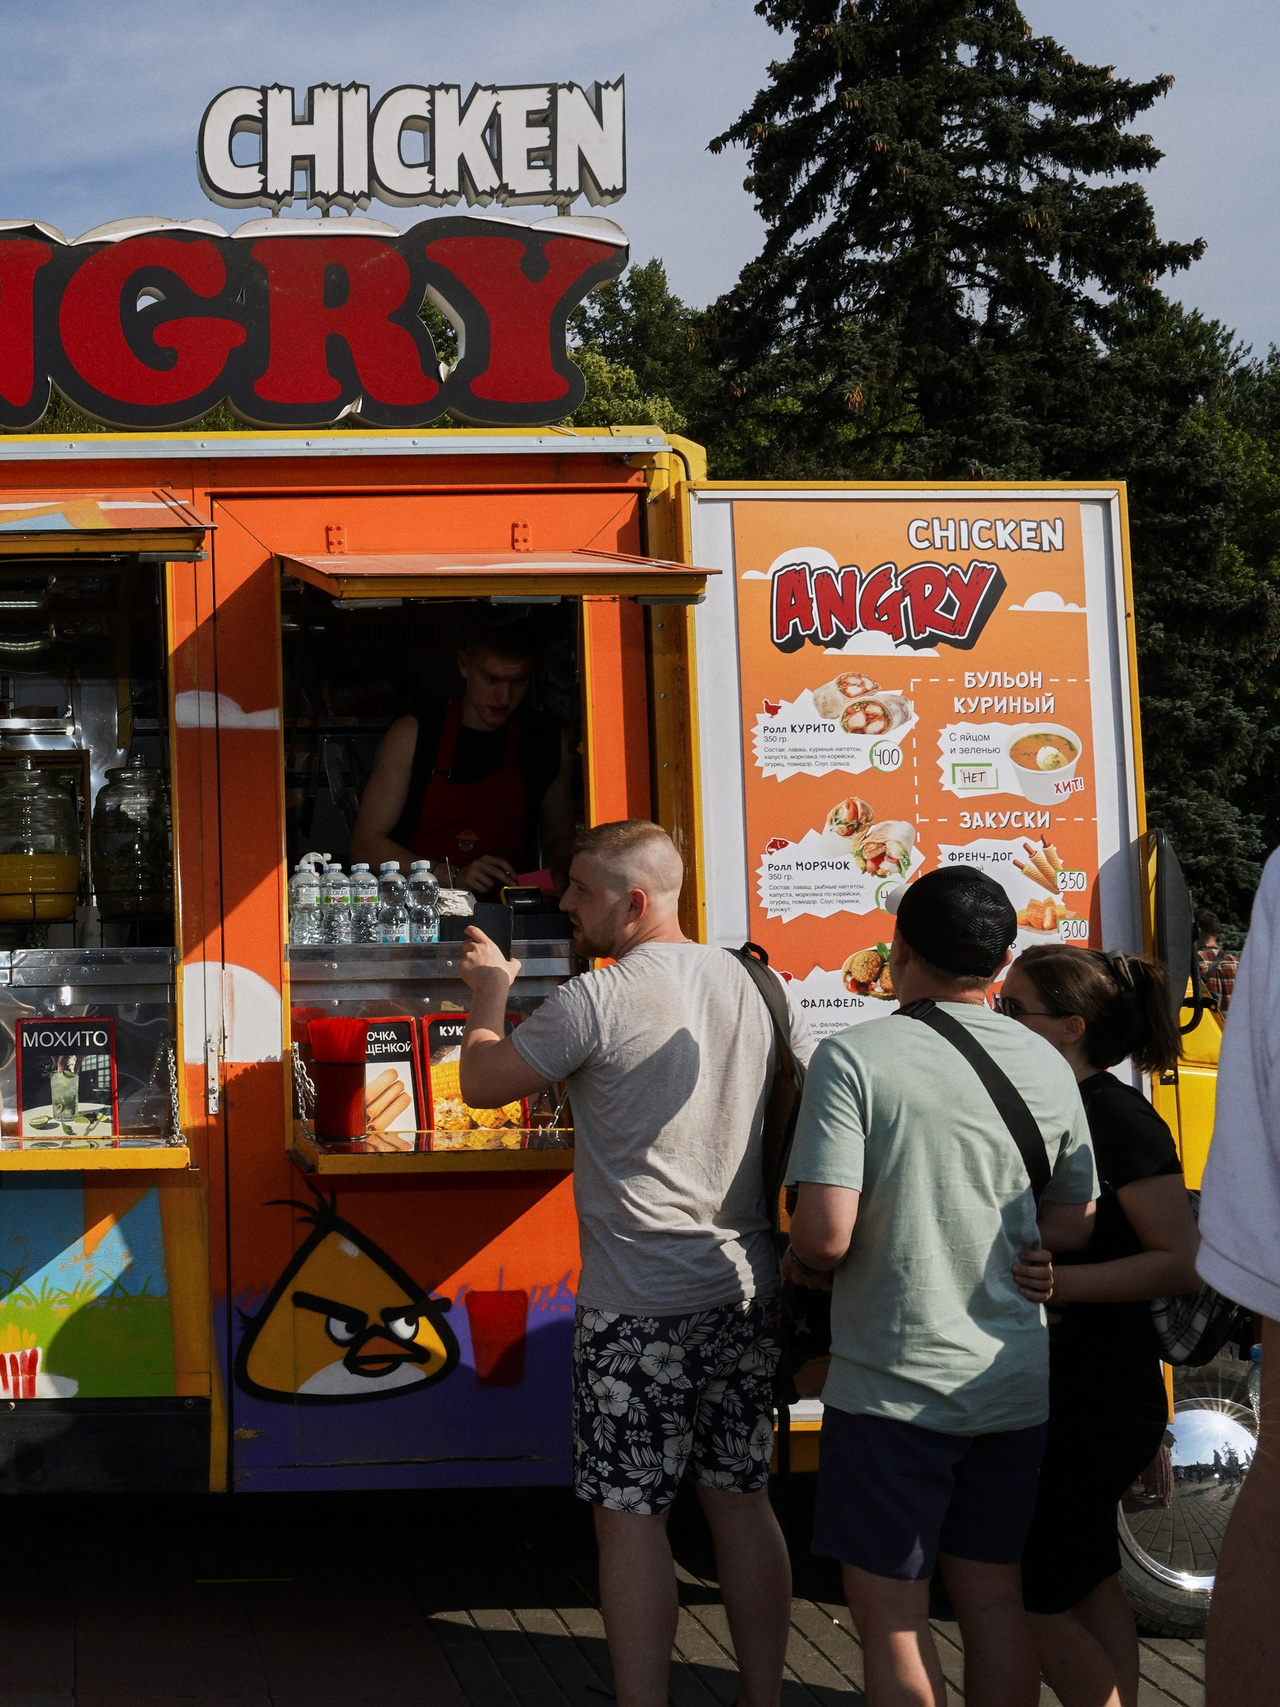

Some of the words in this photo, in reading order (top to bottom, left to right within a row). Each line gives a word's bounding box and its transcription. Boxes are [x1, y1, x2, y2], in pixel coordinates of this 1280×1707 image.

[201, 82, 626, 205] CHICKEN
[907, 517, 1065, 552] CHICKEN
[772, 560, 1000, 645] ANGRY
[964, 671, 1043, 689] БУЛЬОН
[953, 692, 1055, 714] КУРИНЫЙ
[763, 725, 787, 734] Ролл
[790, 723, 836, 734] КУРИТО
[763, 735, 778, 743] 350
[779, 736, 789, 745] гр.
[949, 732, 956, 742] С
[959, 731, 990, 743] яйцом
[763, 746, 786, 754] Состав:
[809, 747, 833, 755] куриные
[959, 746, 1001, 755] зеленью
[873, 748, 900, 766] 400
[814, 760, 828, 768] Соус
[962, 771, 986, 784] НЕТ
[1053, 778, 1083, 794] ХИТ!
[959, 811, 1051, 829] ЗАКУСКИ
[948, 851, 1013, 862] ФРЕНЧ-ДОГ
[767, 863, 792, 872] Ролл
[795, 861, 850, 871] МОРЯЧОК
[783, 874, 794, 882] гр.
[1058, 871, 1085, 890] 350
[814, 884, 837, 892] рыбные
[795, 891, 822, 899] морковка
[1061, 920, 1088, 938] 300
[800, 998, 865, 1009] ФАЛАФЕЛЬ
[366, 1030, 397, 1042] ОЧКА
[439, 1025, 465, 1037] КУК
[22, 1030, 109, 1048] МОХИТО
[365, 1041, 412, 1056] ЩЕНКОЙ
